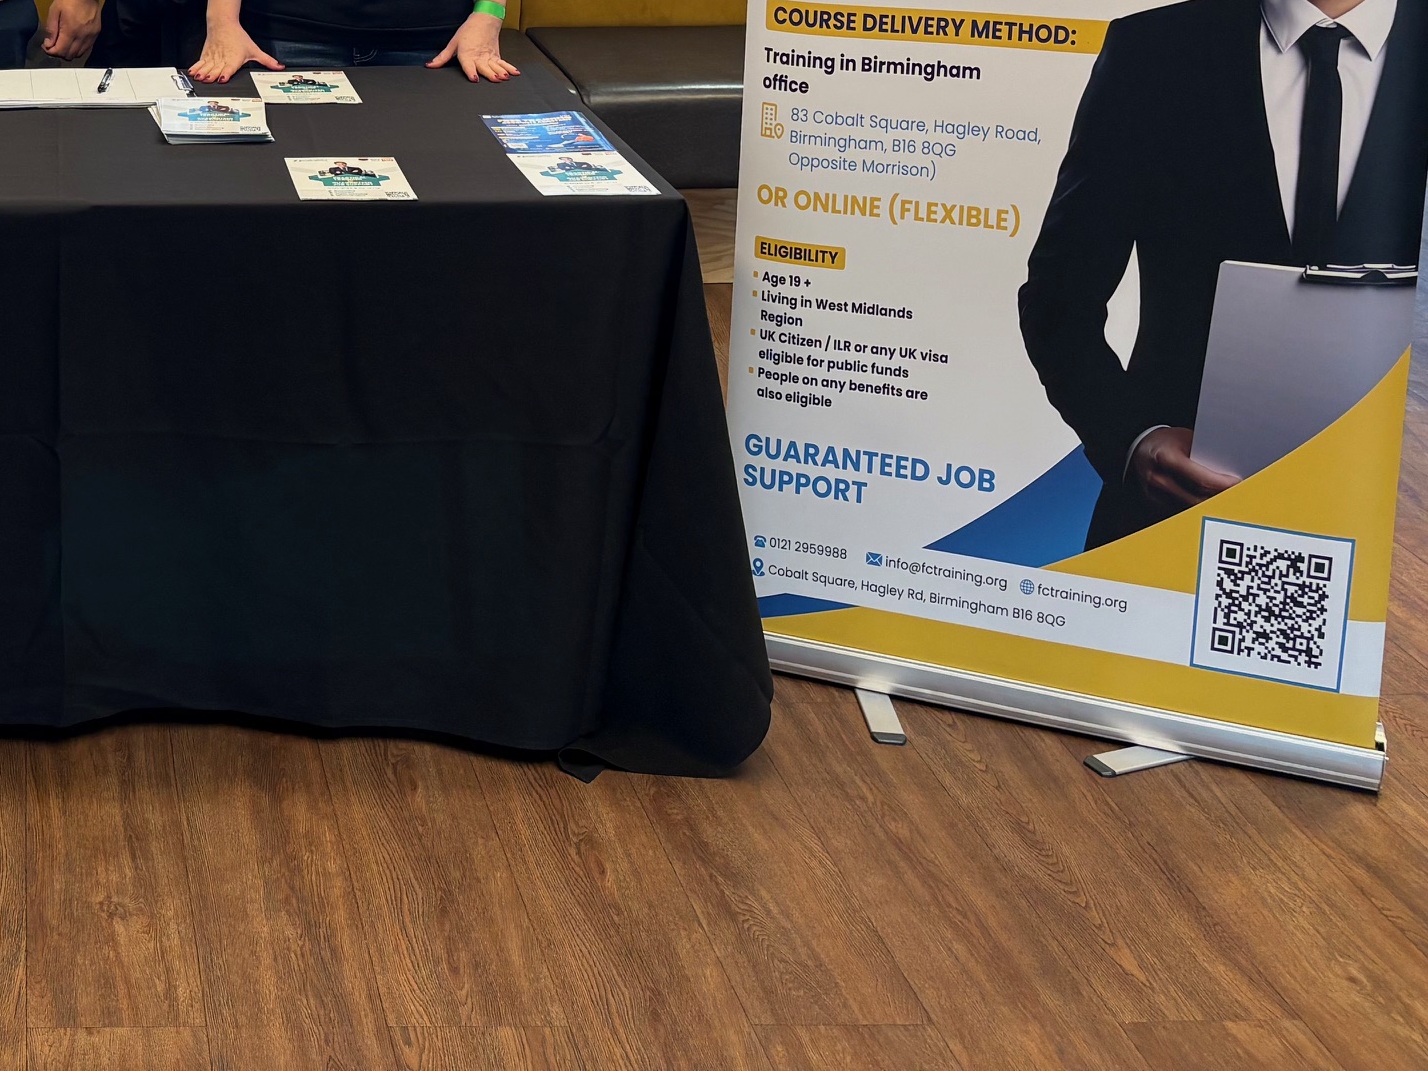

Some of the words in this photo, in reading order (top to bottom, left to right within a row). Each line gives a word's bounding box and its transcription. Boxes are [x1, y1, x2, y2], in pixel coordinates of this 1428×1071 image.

[774, 7, 856, 31] COURSE
[863, 14, 965, 36] DELIVERY
[971, 20, 1076, 45] METHOD:
[765, 47, 835, 75] Training
[840, 53, 856, 71] in
[862, 56, 980, 81] Birmingham
[763, 74, 808, 93] office
[790, 130, 886, 153] Birmingham,
[893, 139, 916, 153] B16
[922, 141, 956, 158] 8QG
[791, 108, 808, 122] 83
[813, 111, 864, 127] Cobalt
[870, 115, 928, 134] Square,
[934, 120, 990, 141] Hagley
[996, 125, 1040, 145] Road,
[789, 153, 857, 172] Opposite
[863, 159, 935, 181] Morrison)
[758, 184, 787, 207] OR
[794, 190, 881, 217] ONLINE
[889, 193, 1020, 237] (FLEXIBLE)
[761, 242, 838, 264] ELIGIBILITY
[745, 434, 929, 481] GUARANTEED
[937, 463, 995, 492] JOB
[744, 464, 867, 503] SUPPORT
[770, 537, 790, 550] 0121
[795, 541, 846, 559] 2959988
[886, 556, 1007, 591] info@fctraining.org
[1038, 584, 1127, 612] fctraining.org
